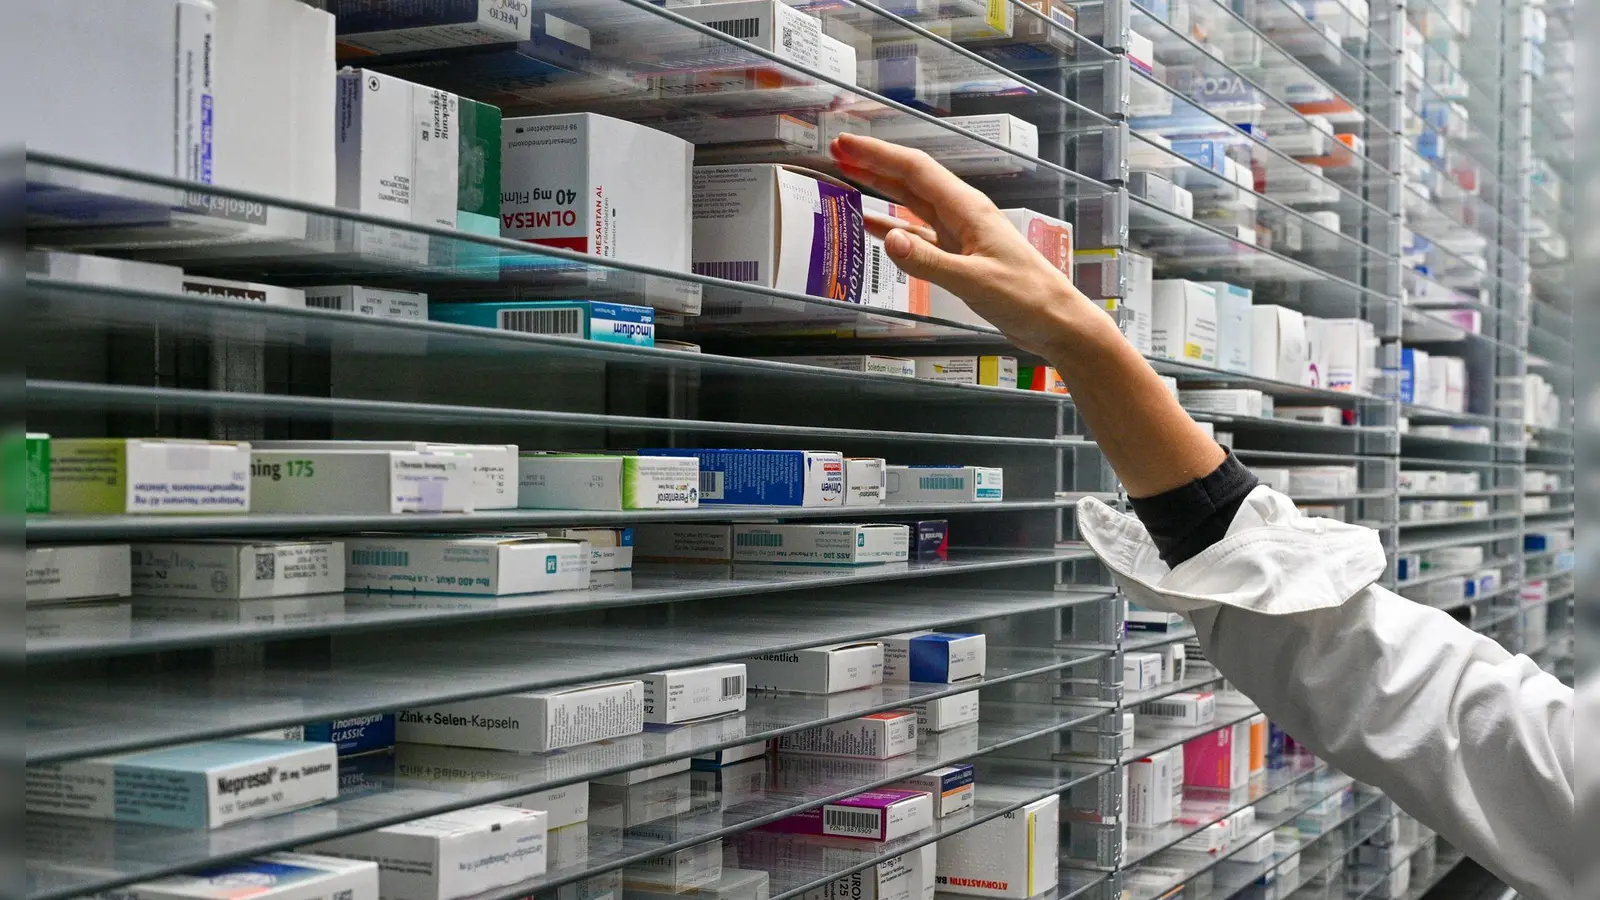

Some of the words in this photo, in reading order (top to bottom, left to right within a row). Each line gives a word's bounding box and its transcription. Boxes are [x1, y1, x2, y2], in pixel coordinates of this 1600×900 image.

[527, 123, 569, 133] Filmtabletten
[508, 137, 578, 148] Olmesartanmedoxomil
[533, 188, 552, 200] mg
[555, 189, 577, 205] 40
[595, 200, 603, 255] MESARTAN
[839, 195, 848, 279] Schwangerschaft
[845, 193, 864, 304] femibion
[834, 282, 847, 301] 2
[613, 322, 652, 339] Imodium
[286, 460, 314, 477] 175
[656, 493, 689, 504] Perenterol
[155, 570, 168, 580] N2
[436, 575, 456, 586] akut
[458, 577, 474, 587] 400
[476, 577, 490, 588] Ibu
[747, 652, 800, 664] chentlich
[332, 713, 383, 730] Thomapyrin
[331, 727, 366, 742] CLASSIC
[935, 876, 948, 885] BA
[949, 876, 1009, 891] ATORVASTATIN
